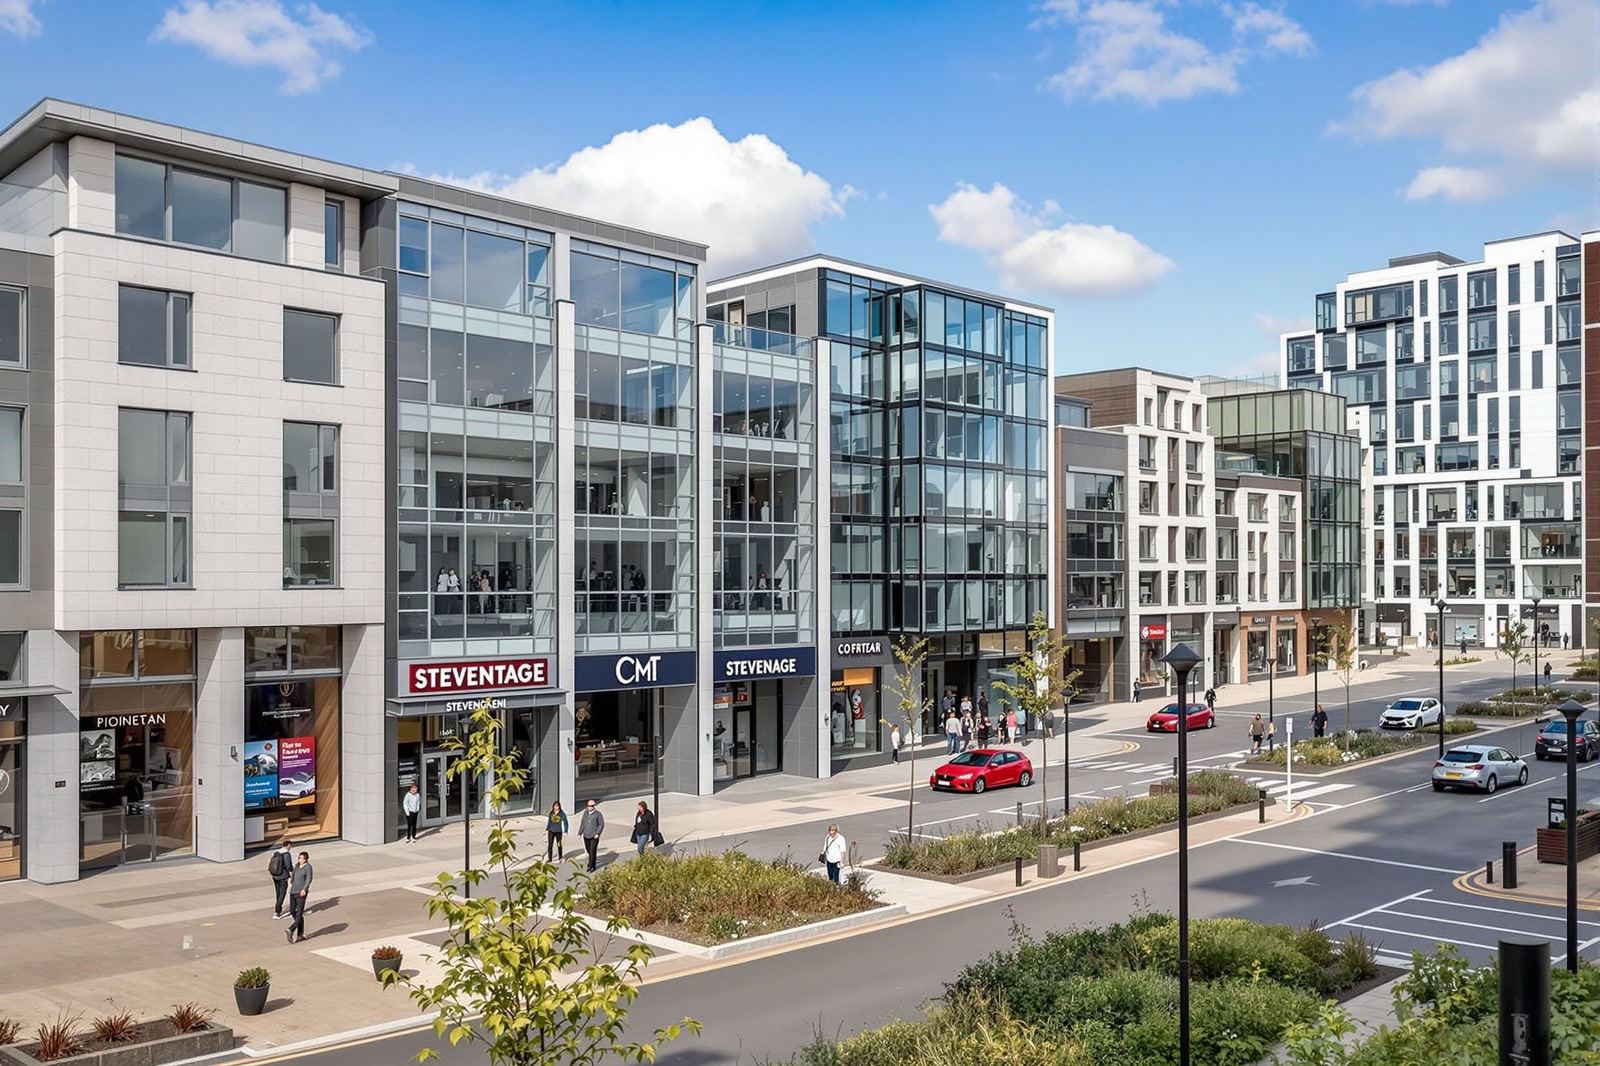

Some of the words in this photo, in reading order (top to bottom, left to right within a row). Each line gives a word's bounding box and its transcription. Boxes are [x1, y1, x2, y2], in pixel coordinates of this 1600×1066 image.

[415, 663, 545, 689] STEVENTAGE
[615, 656, 661, 684] CMT
[726, 658, 796, 676] STEVENAGE
